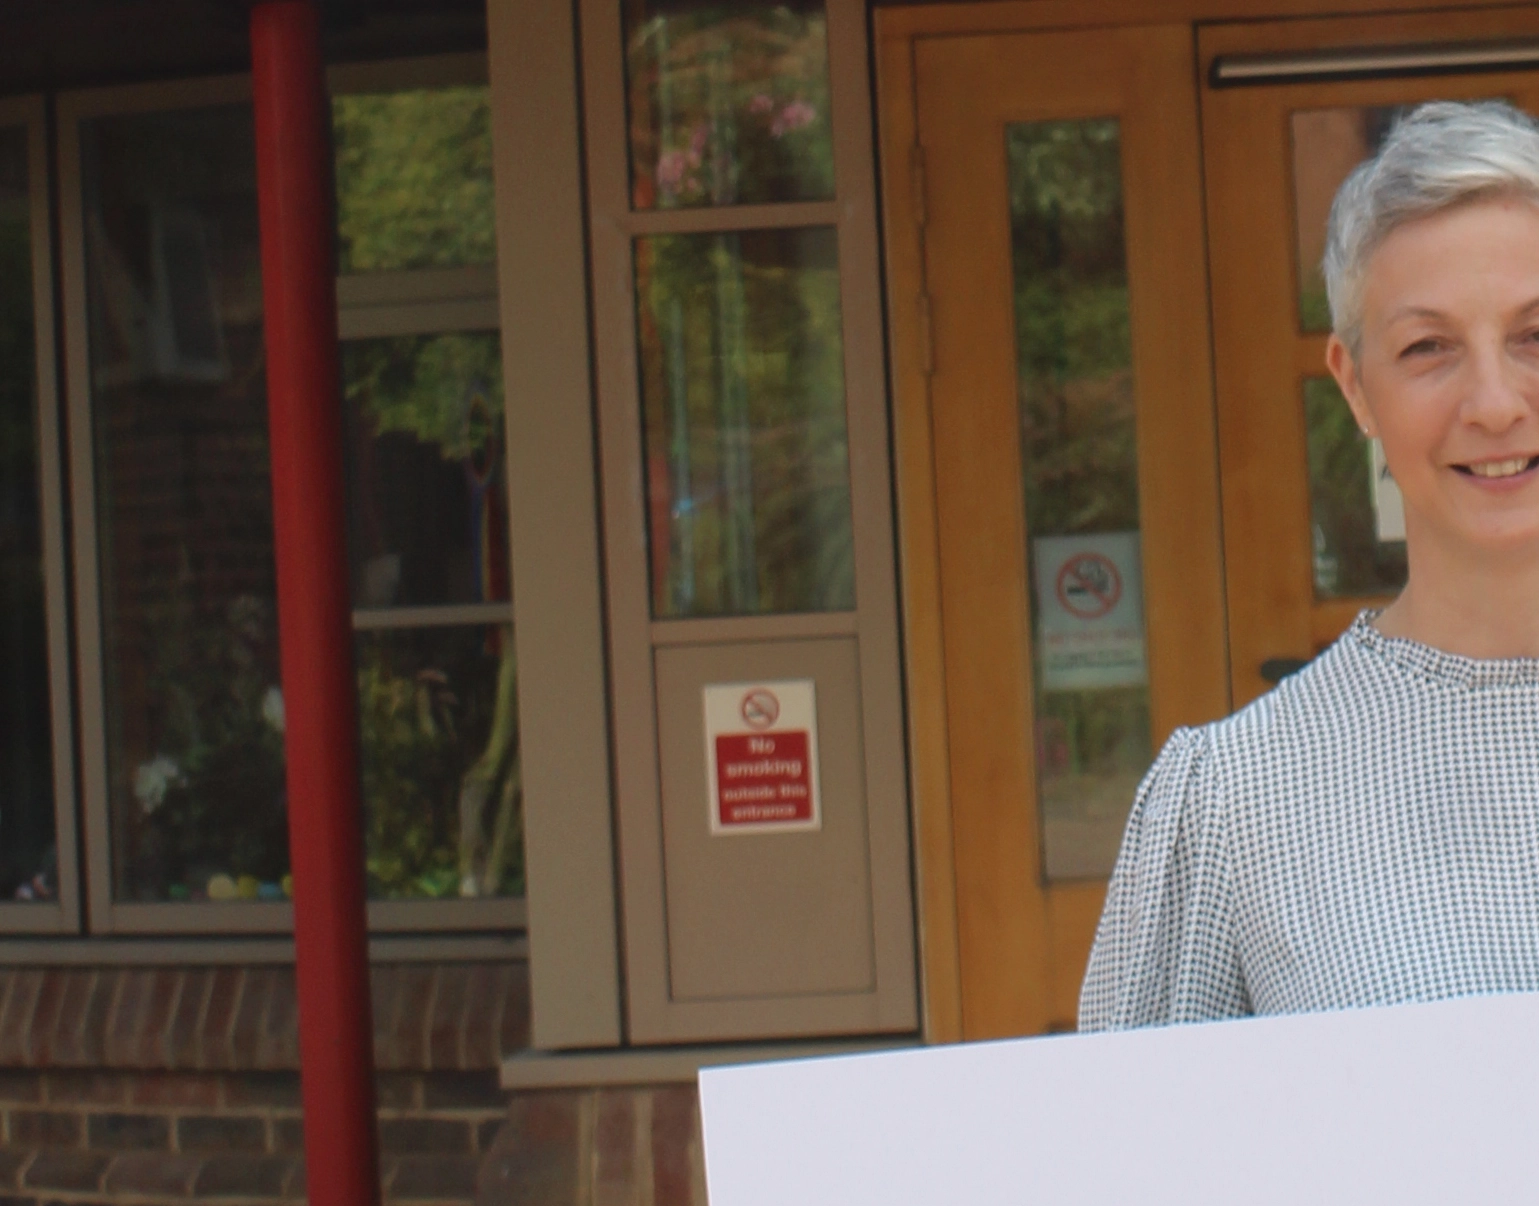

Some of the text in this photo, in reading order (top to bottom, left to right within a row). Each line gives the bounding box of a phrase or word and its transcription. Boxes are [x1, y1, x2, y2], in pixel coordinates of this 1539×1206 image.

[749, 737, 776, 755] No
[726, 759, 803, 778] smoking
[732, 803, 797, 820] entrance
